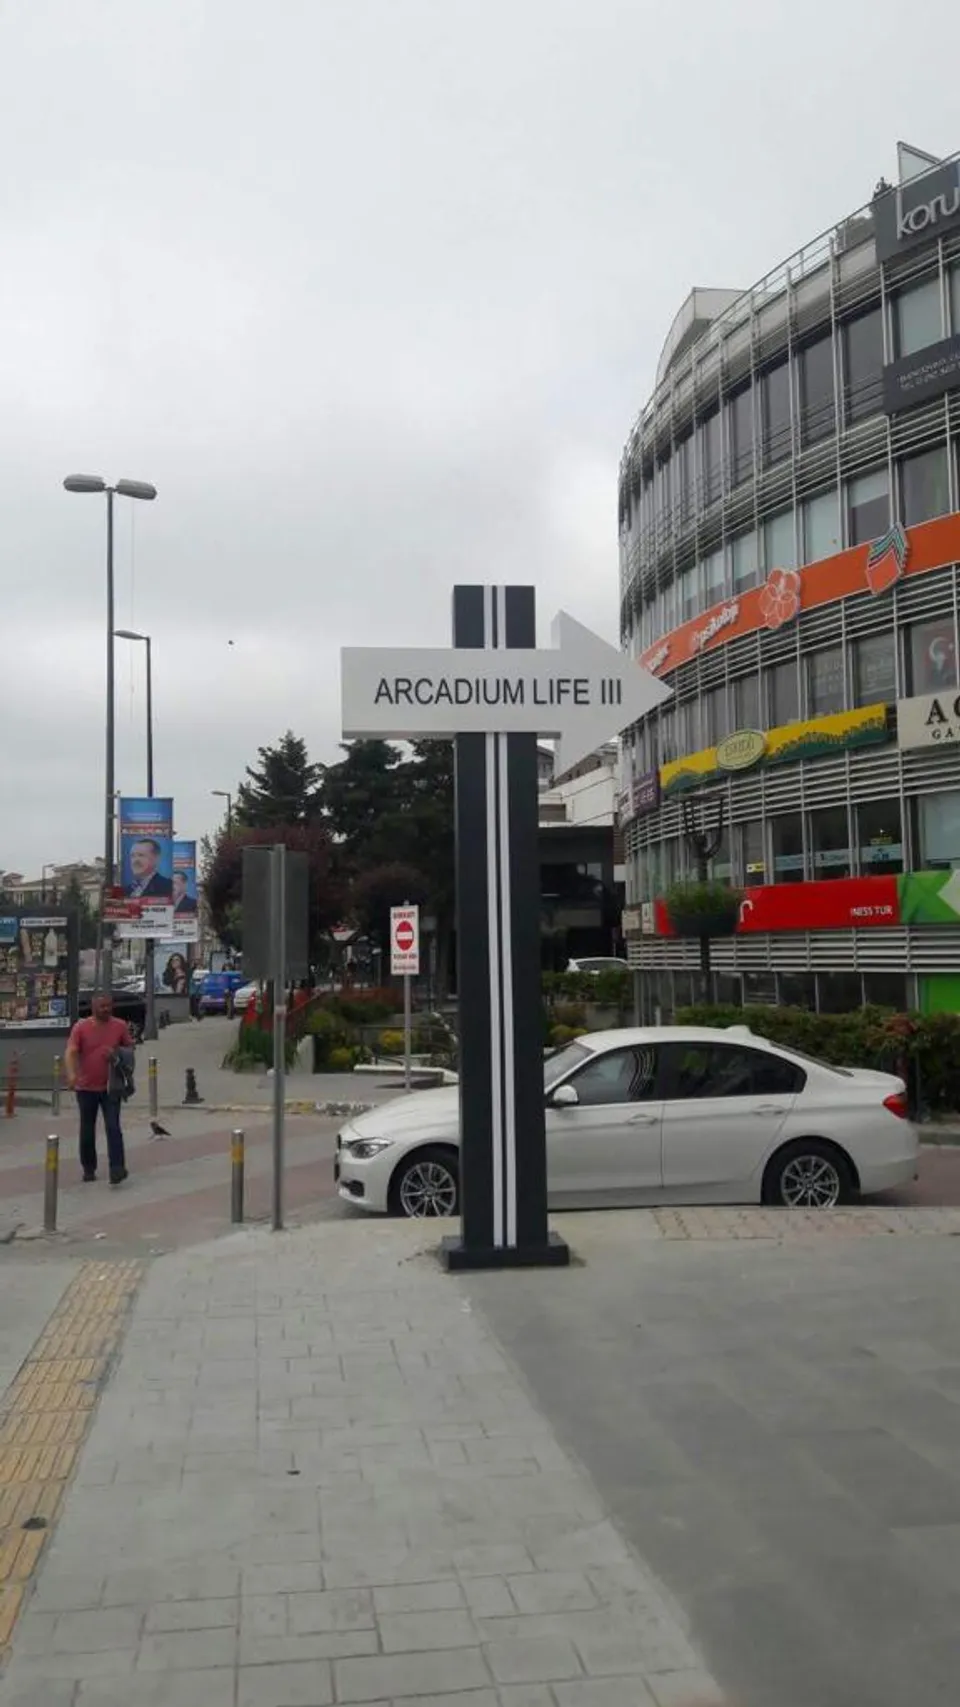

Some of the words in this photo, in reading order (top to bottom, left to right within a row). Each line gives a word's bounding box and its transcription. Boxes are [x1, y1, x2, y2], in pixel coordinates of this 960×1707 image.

[374, 678, 524, 705] ARCADIUM
[533, 678, 590, 705] LIFE
[601, 678, 622, 705] III
[931, 725, 960, 740] GA
